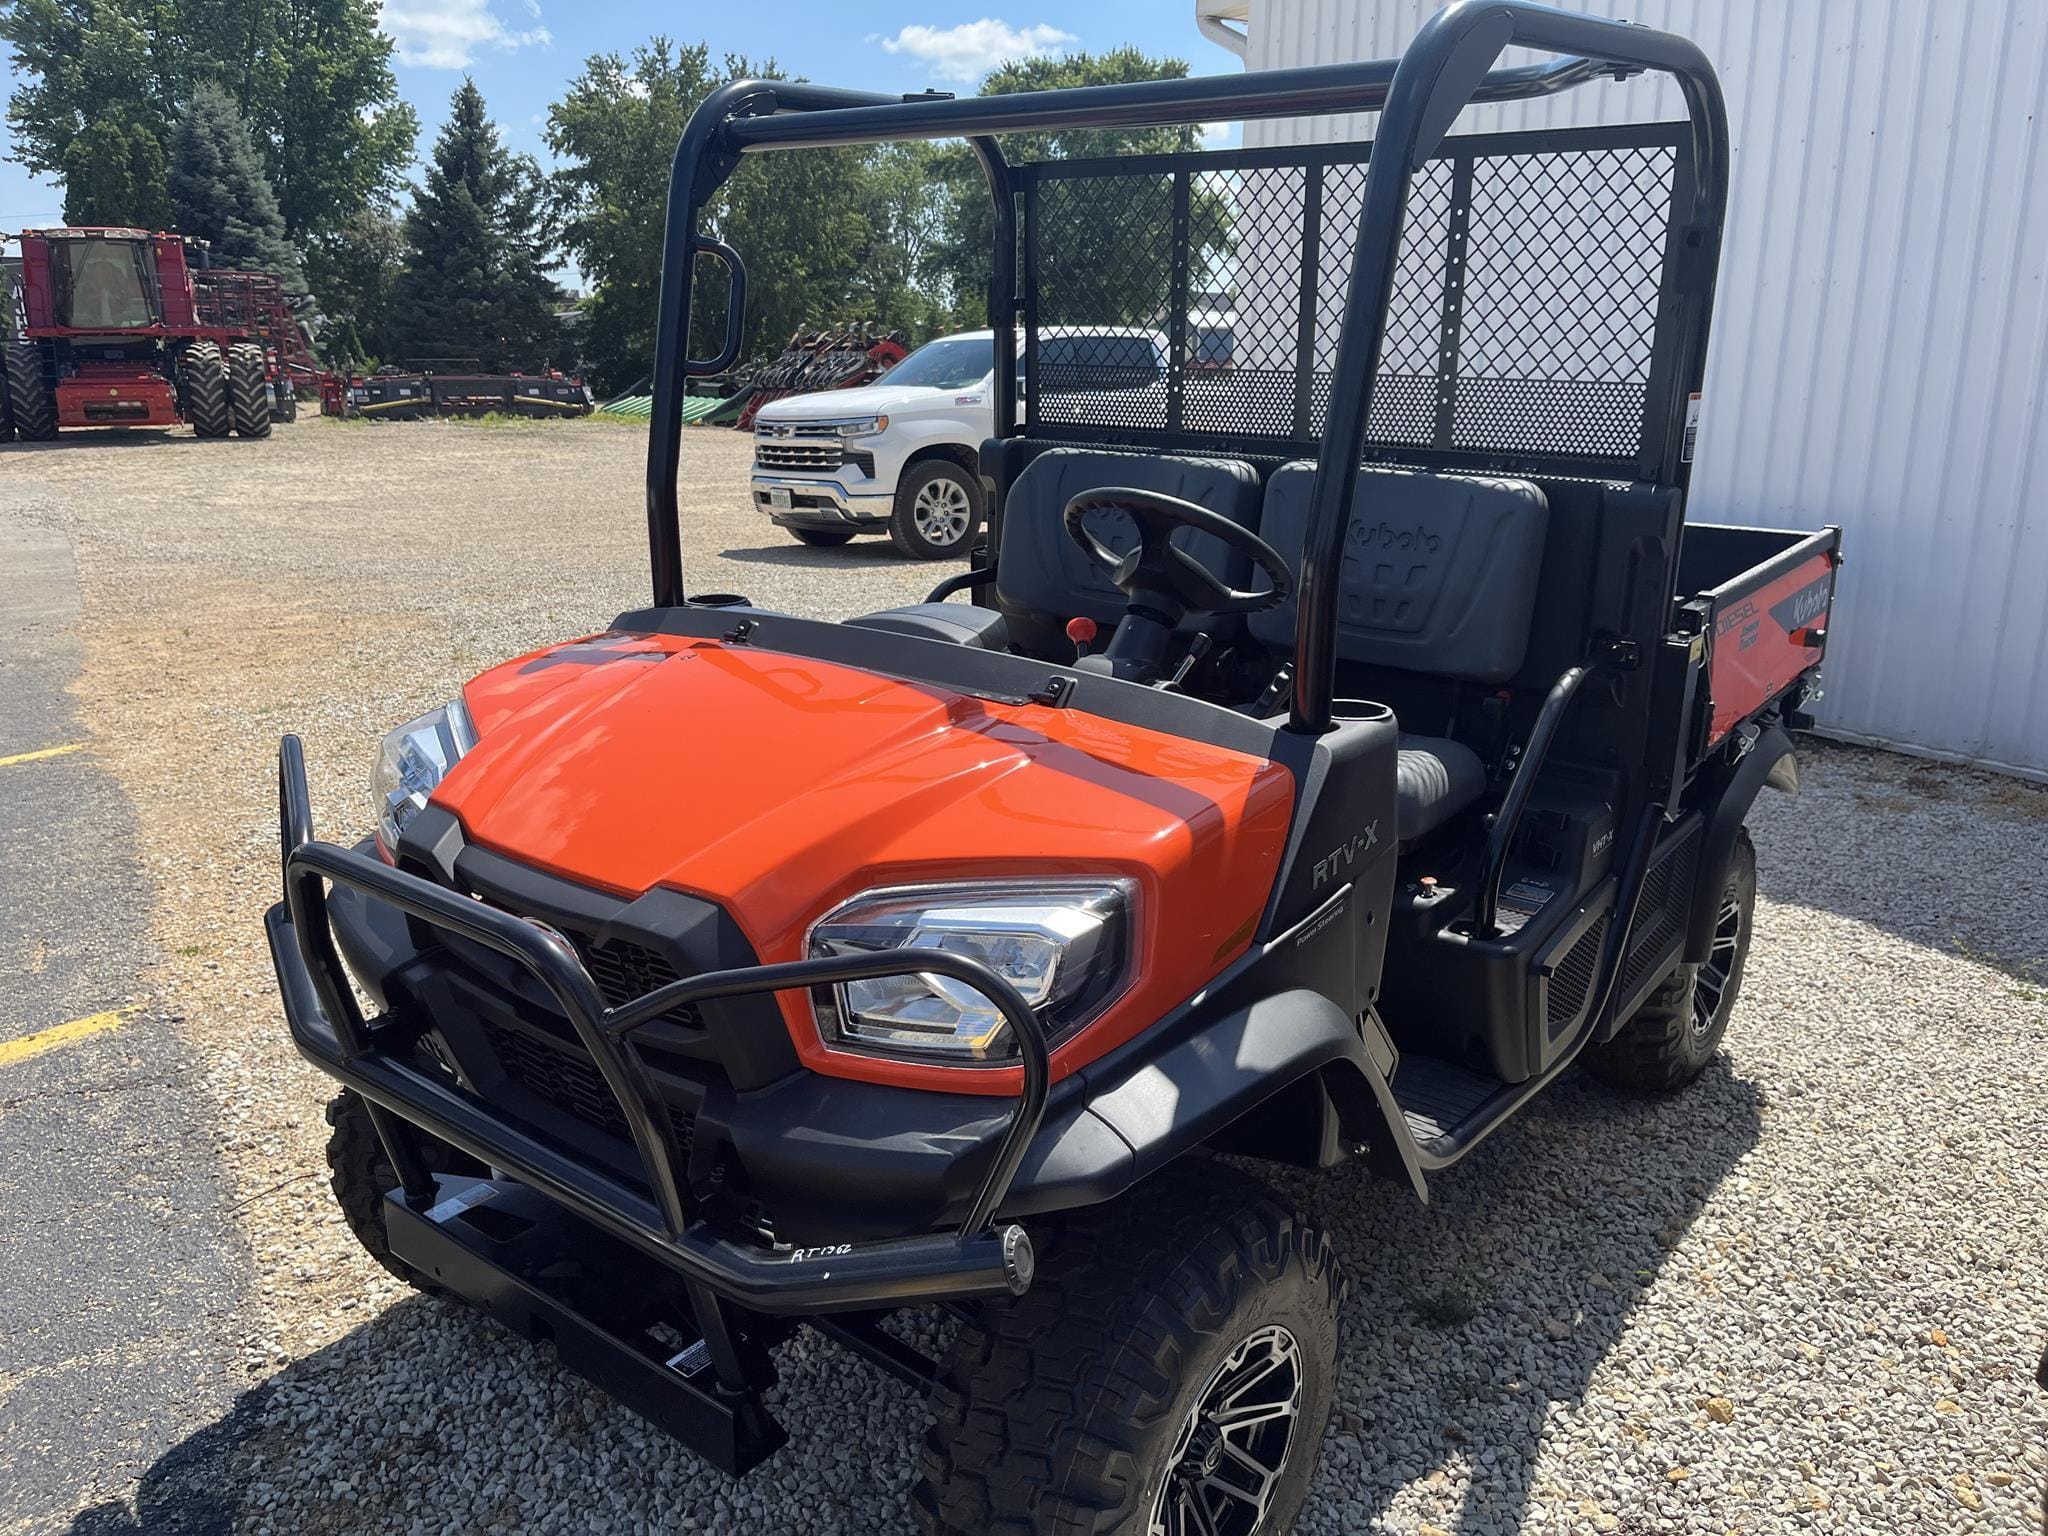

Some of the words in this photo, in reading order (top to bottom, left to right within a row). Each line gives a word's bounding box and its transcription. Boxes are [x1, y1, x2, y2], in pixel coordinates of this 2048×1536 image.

[1717, 601, 1759, 636] DIESEL
[1793, 583, 1828, 624] Kubota
[1312, 819, 1378, 890] RTV-X
[1592, 828, 1615, 853] VHT-X
[1296, 927, 1317, 947] Power
[1317, 905, 1344, 931] Steering
